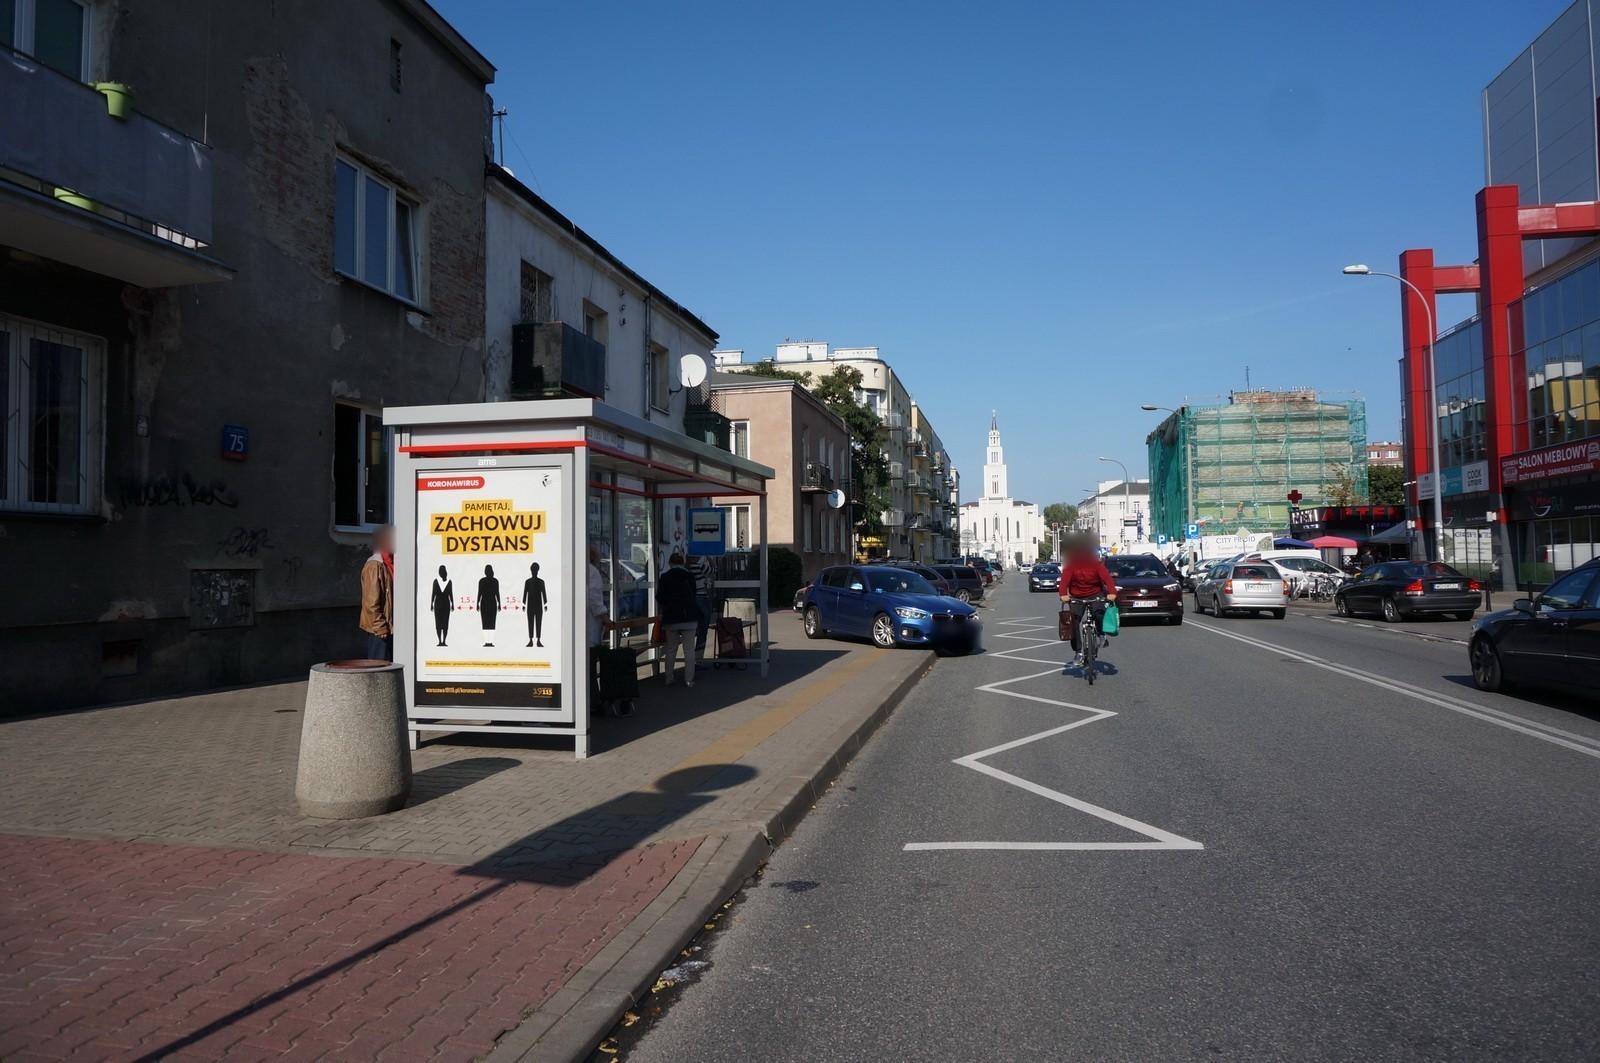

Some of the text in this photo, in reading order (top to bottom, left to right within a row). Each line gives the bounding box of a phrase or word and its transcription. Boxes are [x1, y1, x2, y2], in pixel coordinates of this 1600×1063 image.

[229, 433, 244, 452] 75
[1518, 444, 1587, 469] SALON MEBLOWY
[427, 479, 480, 488] KORONAWIRUS
[465, 502, 511, 513] PAMIĘTAJ,
[434, 514, 542, 533] ZACHOWUJ
[1188, 524, 1197, 535] P
[446, 535, 530, 553] DYSTANS
[1158, 534, 1166, 544] P
[533, 687, 553, 697] 19115
